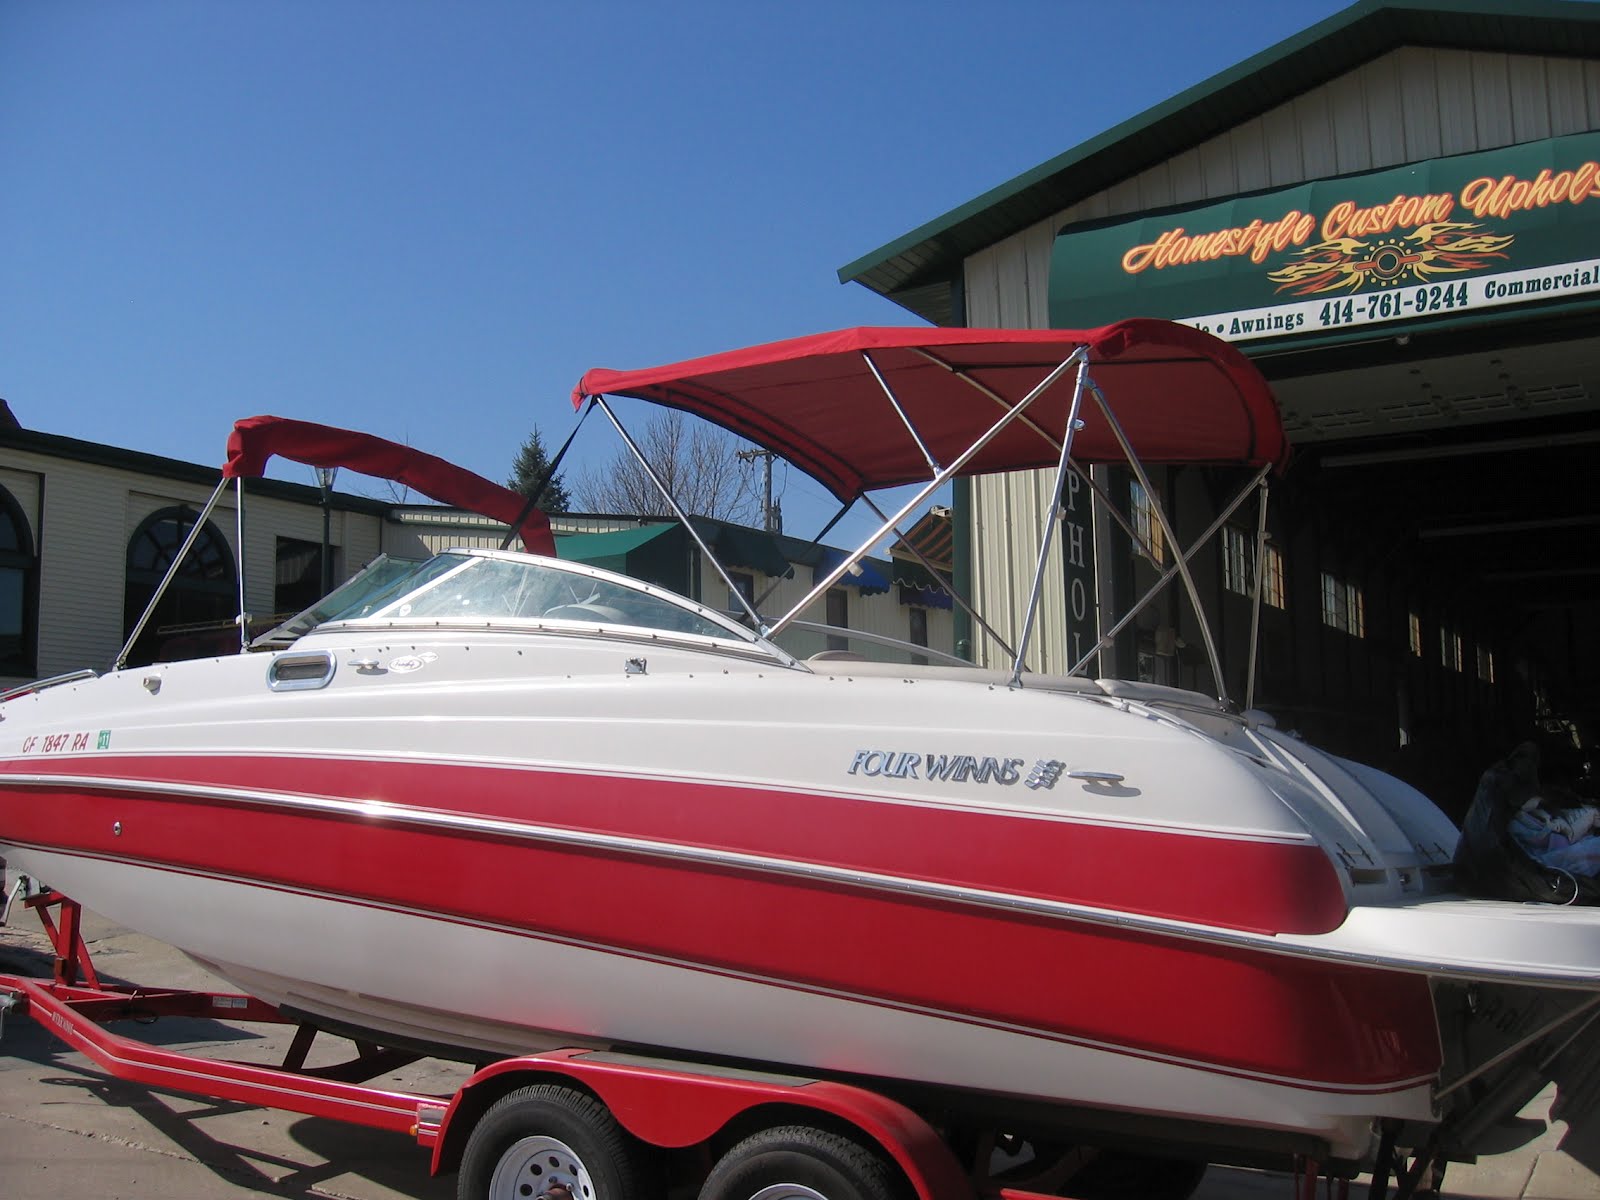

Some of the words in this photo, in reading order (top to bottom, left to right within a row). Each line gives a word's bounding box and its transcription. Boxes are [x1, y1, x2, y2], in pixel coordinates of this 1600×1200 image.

[1122, 209, 1316, 274] Homestyle
[1323, 192, 1455, 241] Custom
[1229, 312, 1304, 335] Awnings
[1319, 281, 1468, 326] 414-761-9244
[1484, 265, 1600, 299] Commercial
[23, 736, 38, 753] CF
[41, 734, 69, 753] 1847
[71, 732, 90, 751] RA
[848, 750, 920, 780] FOUR
[925, 753, 1025, 786] WINNS
